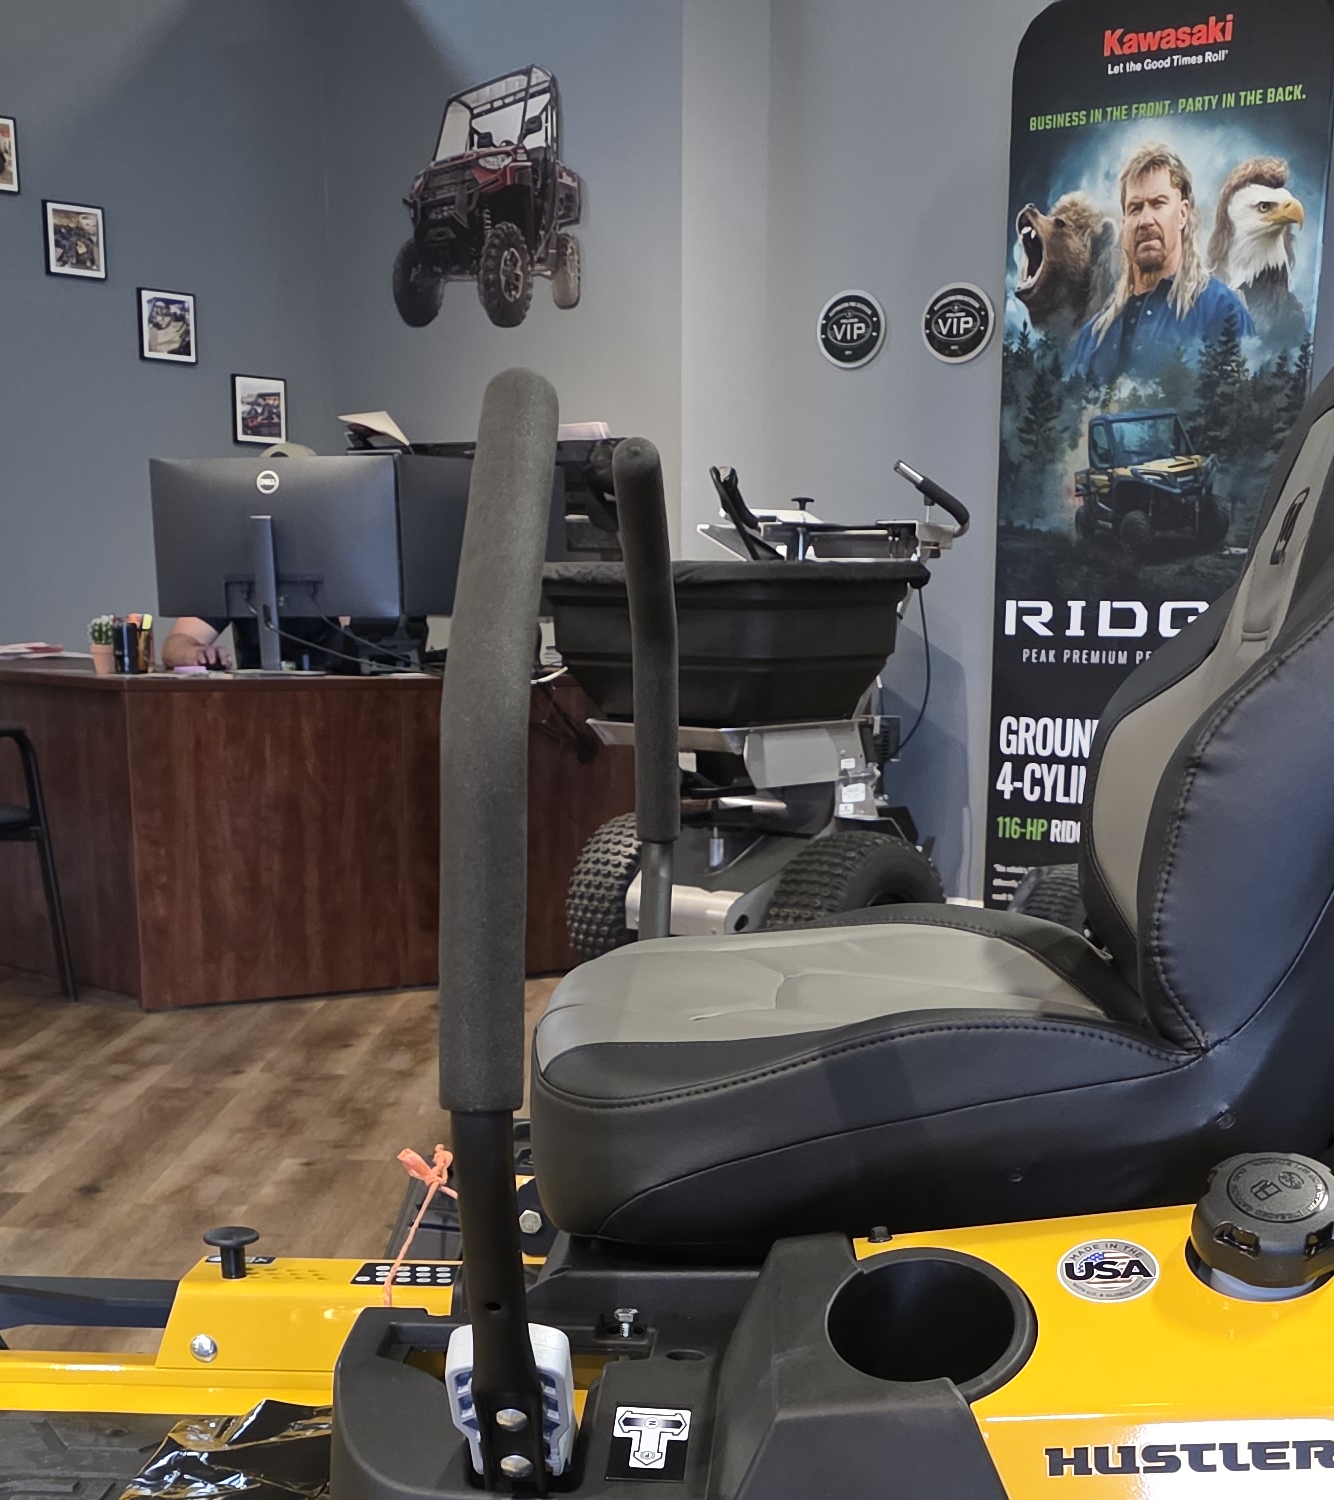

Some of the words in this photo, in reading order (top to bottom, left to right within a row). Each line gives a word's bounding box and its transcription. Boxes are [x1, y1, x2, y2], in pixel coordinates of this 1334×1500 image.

[1103, 13, 1234, 57] Kawasaki
[1107, 62, 1124, 75] Let
[1125, 60, 1142, 73] the
[1143, 56, 1171, 72] Good
[1172, 52, 1203, 68] Times
[1029, 107, 1087, 132] BUSINESS
[1089, 108, 1103, 124] IN
[1106, 105, 1129, 122] THE
[1131, 100, 1174, 119] FRONT.
[1178, 94, 1219, 114] PARTY
[1222, 92, 1236, 109] IN
[1239, 89, 1264, 107] THE
[1267, 84, 1307, 104] BACK.
[832, 322, 866, 341] VIP
[937, 316, 973, 336] VIP
[1003, 599, 1210, 638] RIDG
[1022, 648, 1056, 664] PEAK
[1063, 649, 1128, 665] PREMIUM
[996, 816, 1048, 842] 116-HP
[1069, 1243, 1100, 1261] MADE
[1123, 1245, 1144, 1258] THE
[1064, 1260, 1154, 1281] USA
